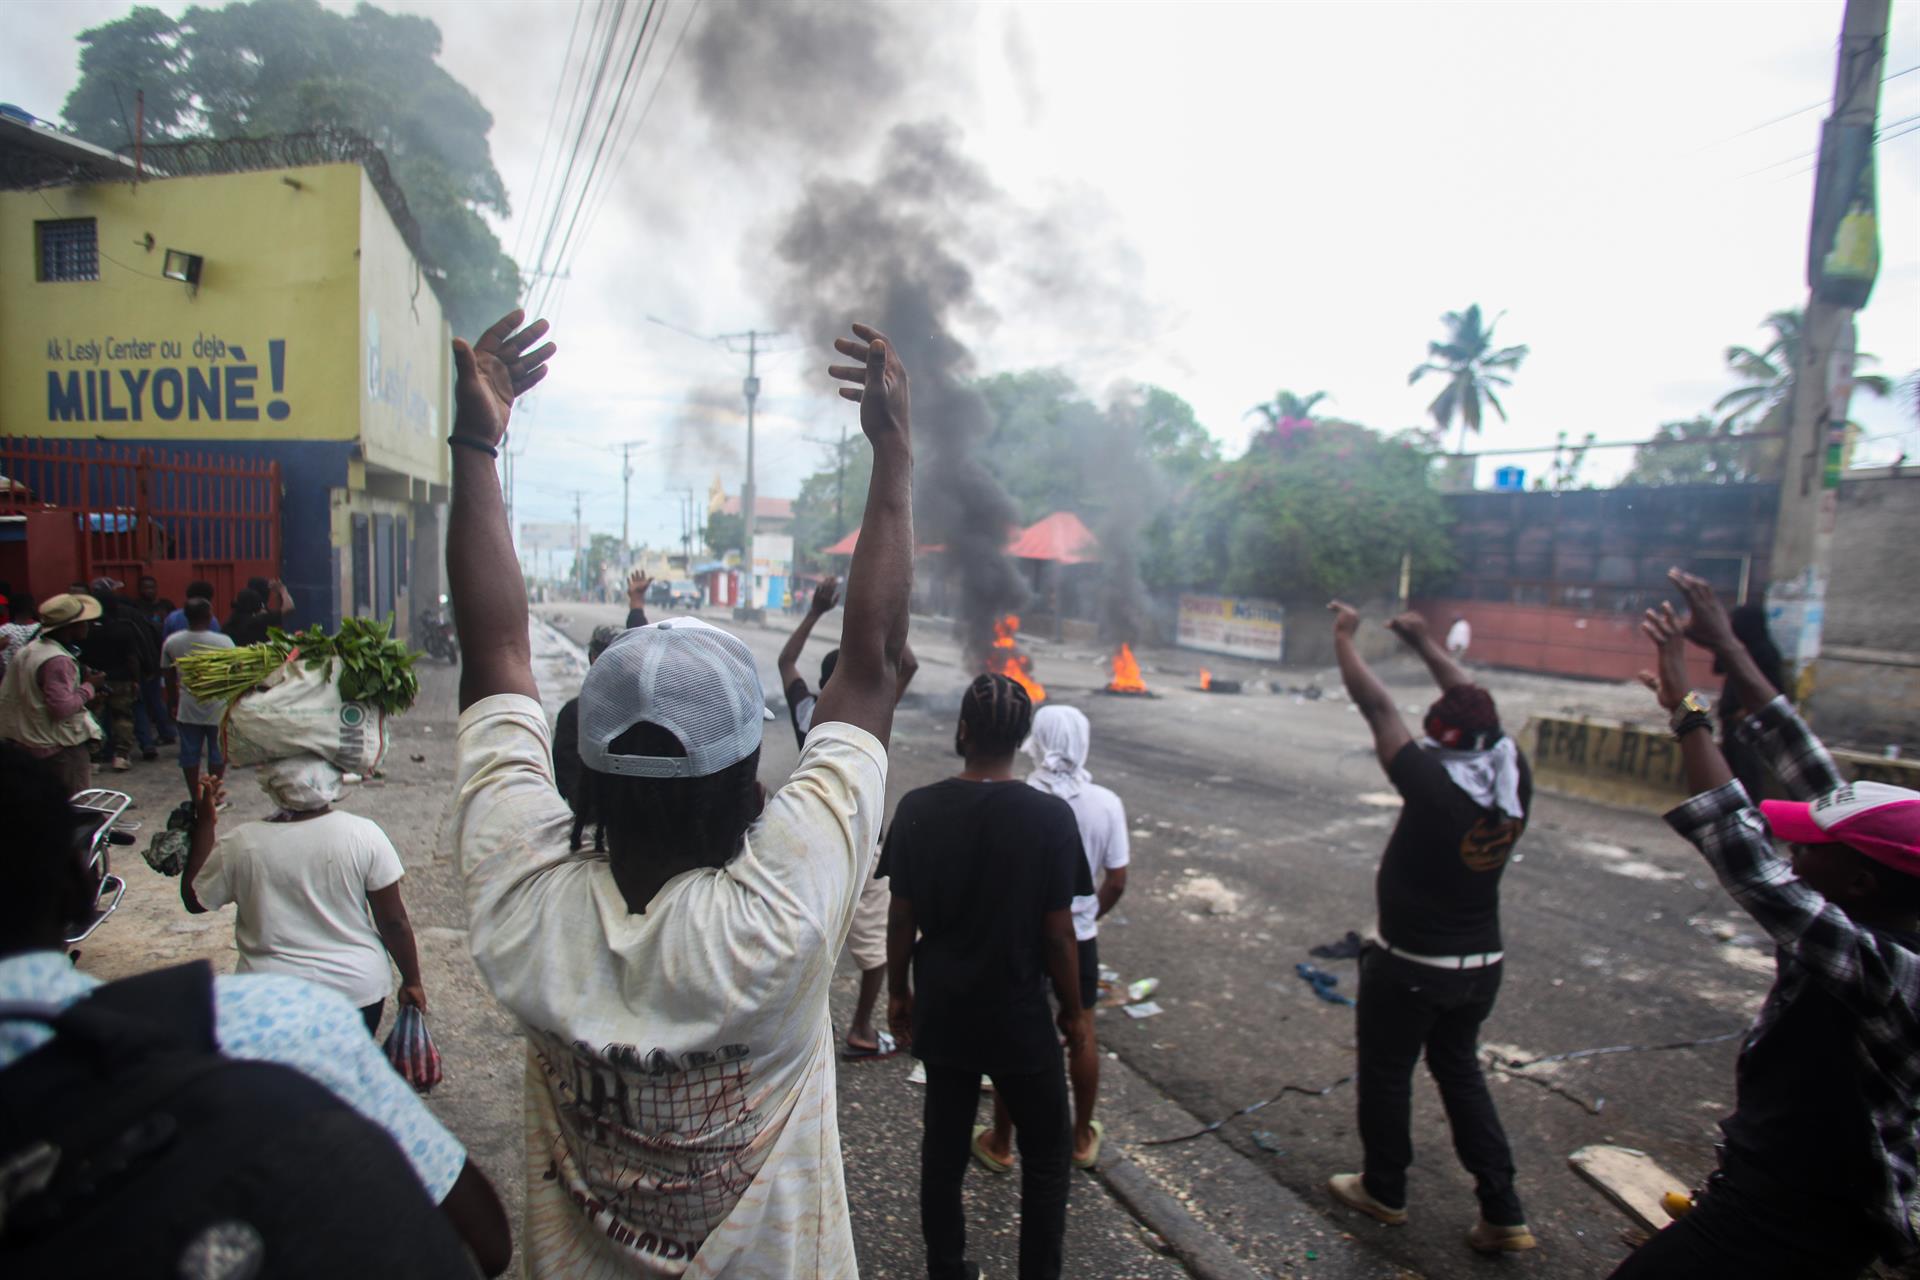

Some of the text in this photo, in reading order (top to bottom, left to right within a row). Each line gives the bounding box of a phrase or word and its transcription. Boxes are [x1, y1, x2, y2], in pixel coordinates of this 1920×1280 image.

[67, 338, 101, 367] Lesly
[106, 336, 156, 361] Center
[161, 341, 182, 359] ou
